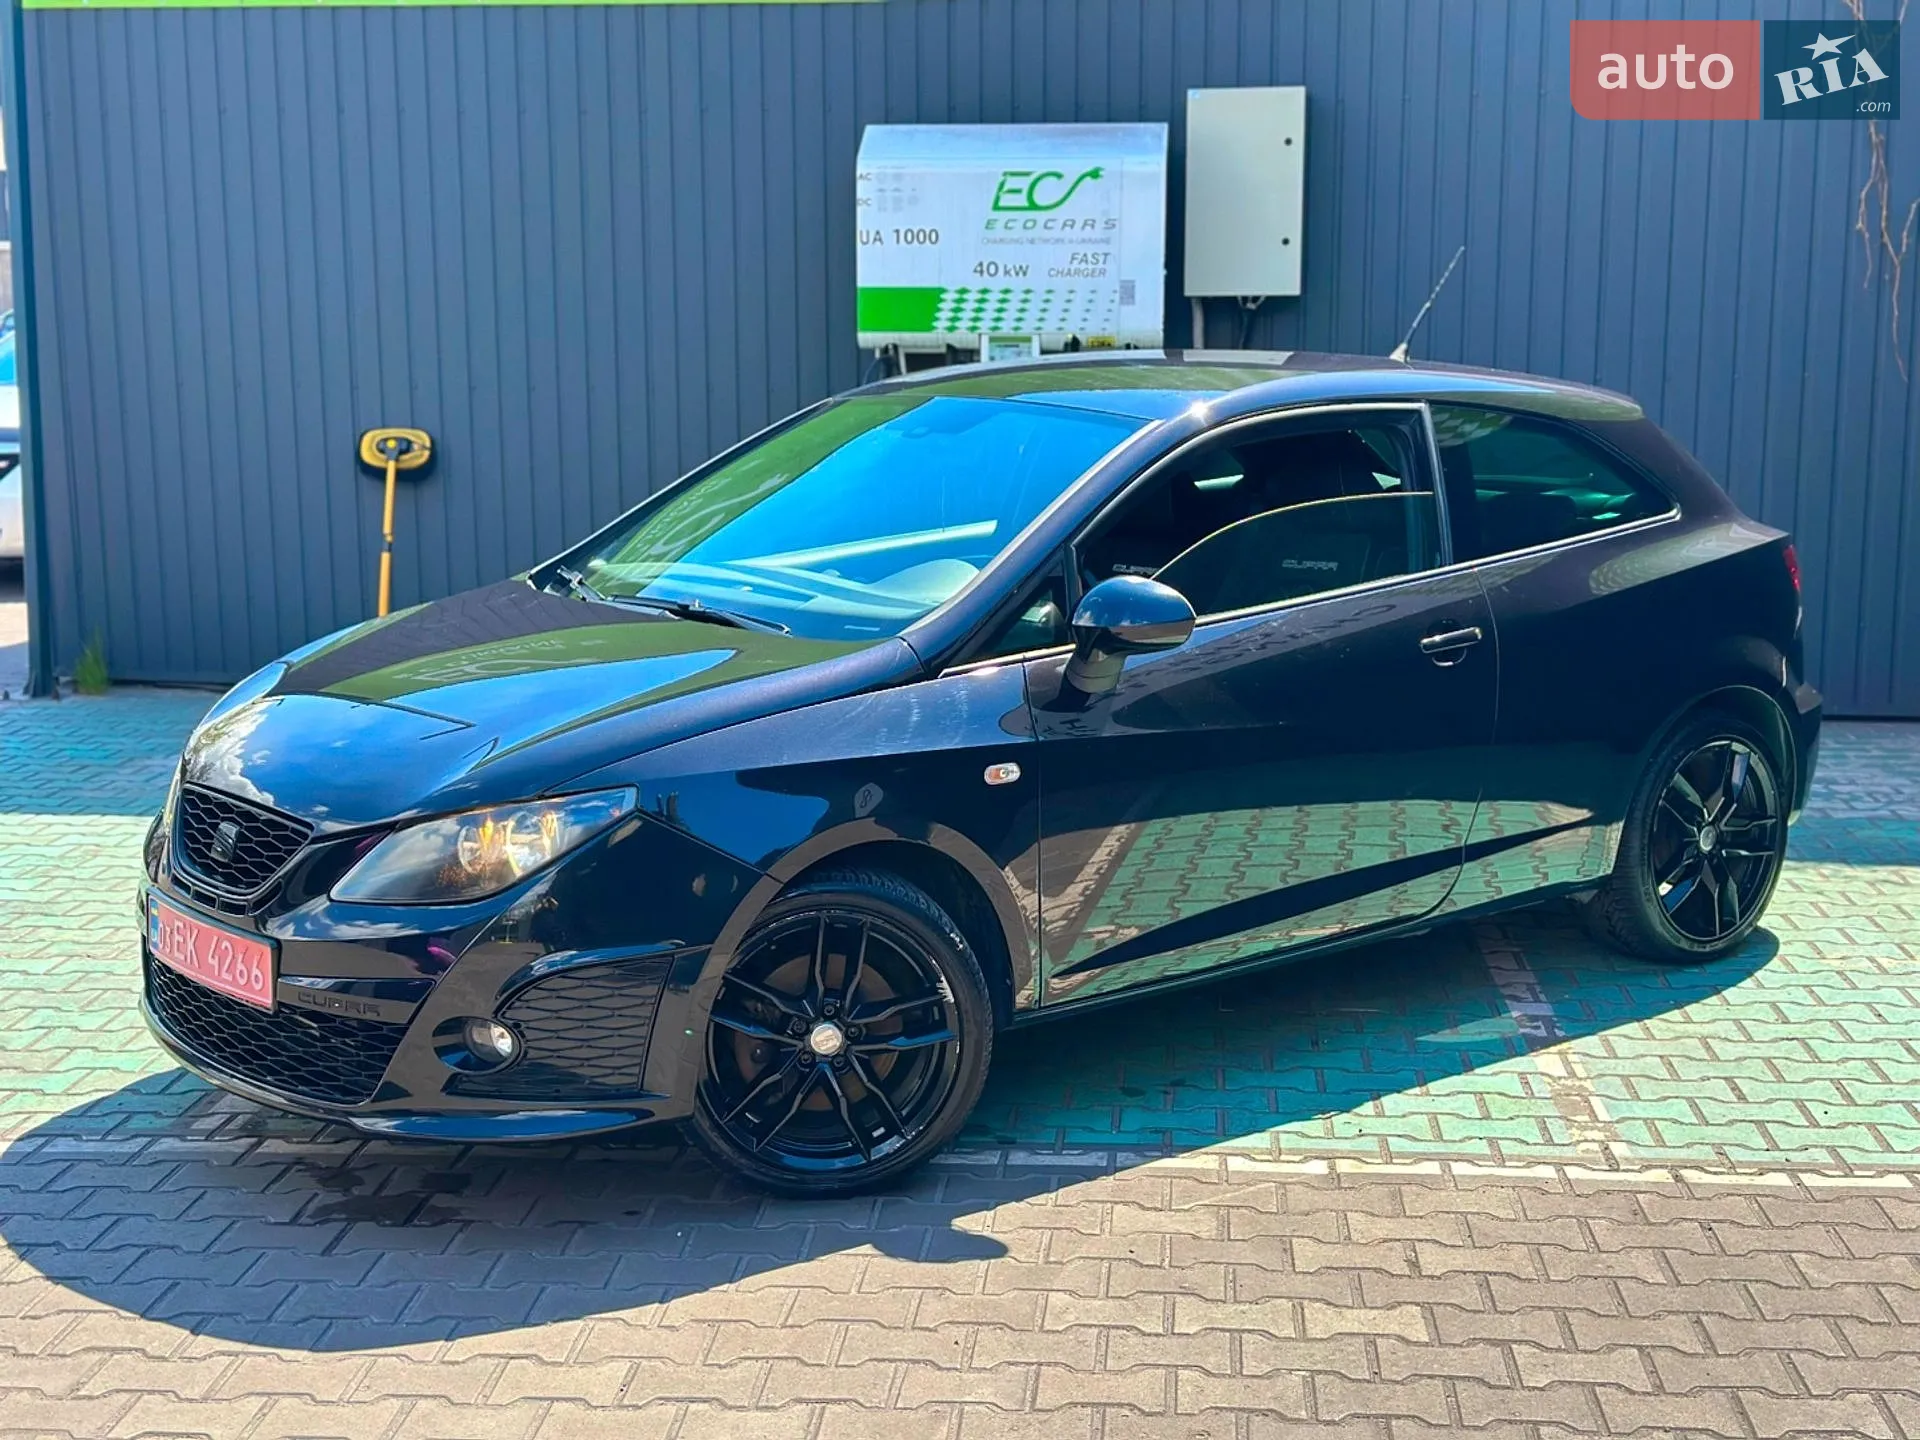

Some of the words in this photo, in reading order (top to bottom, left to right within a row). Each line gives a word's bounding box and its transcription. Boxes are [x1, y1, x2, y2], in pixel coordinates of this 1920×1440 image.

[984, 218, 1117, 231] ECOCARS
[859, 229, 884, 246] UA
[893, 228, 939, 245] 1000
[1069, 252, 1112, 265] FAST
[972, 261, 999, 277] 40
[1003, 264, 1030, 277] kW
[1047, 267, 1107, 278] CHARGER
[208, 935, 264, 991] 4266
